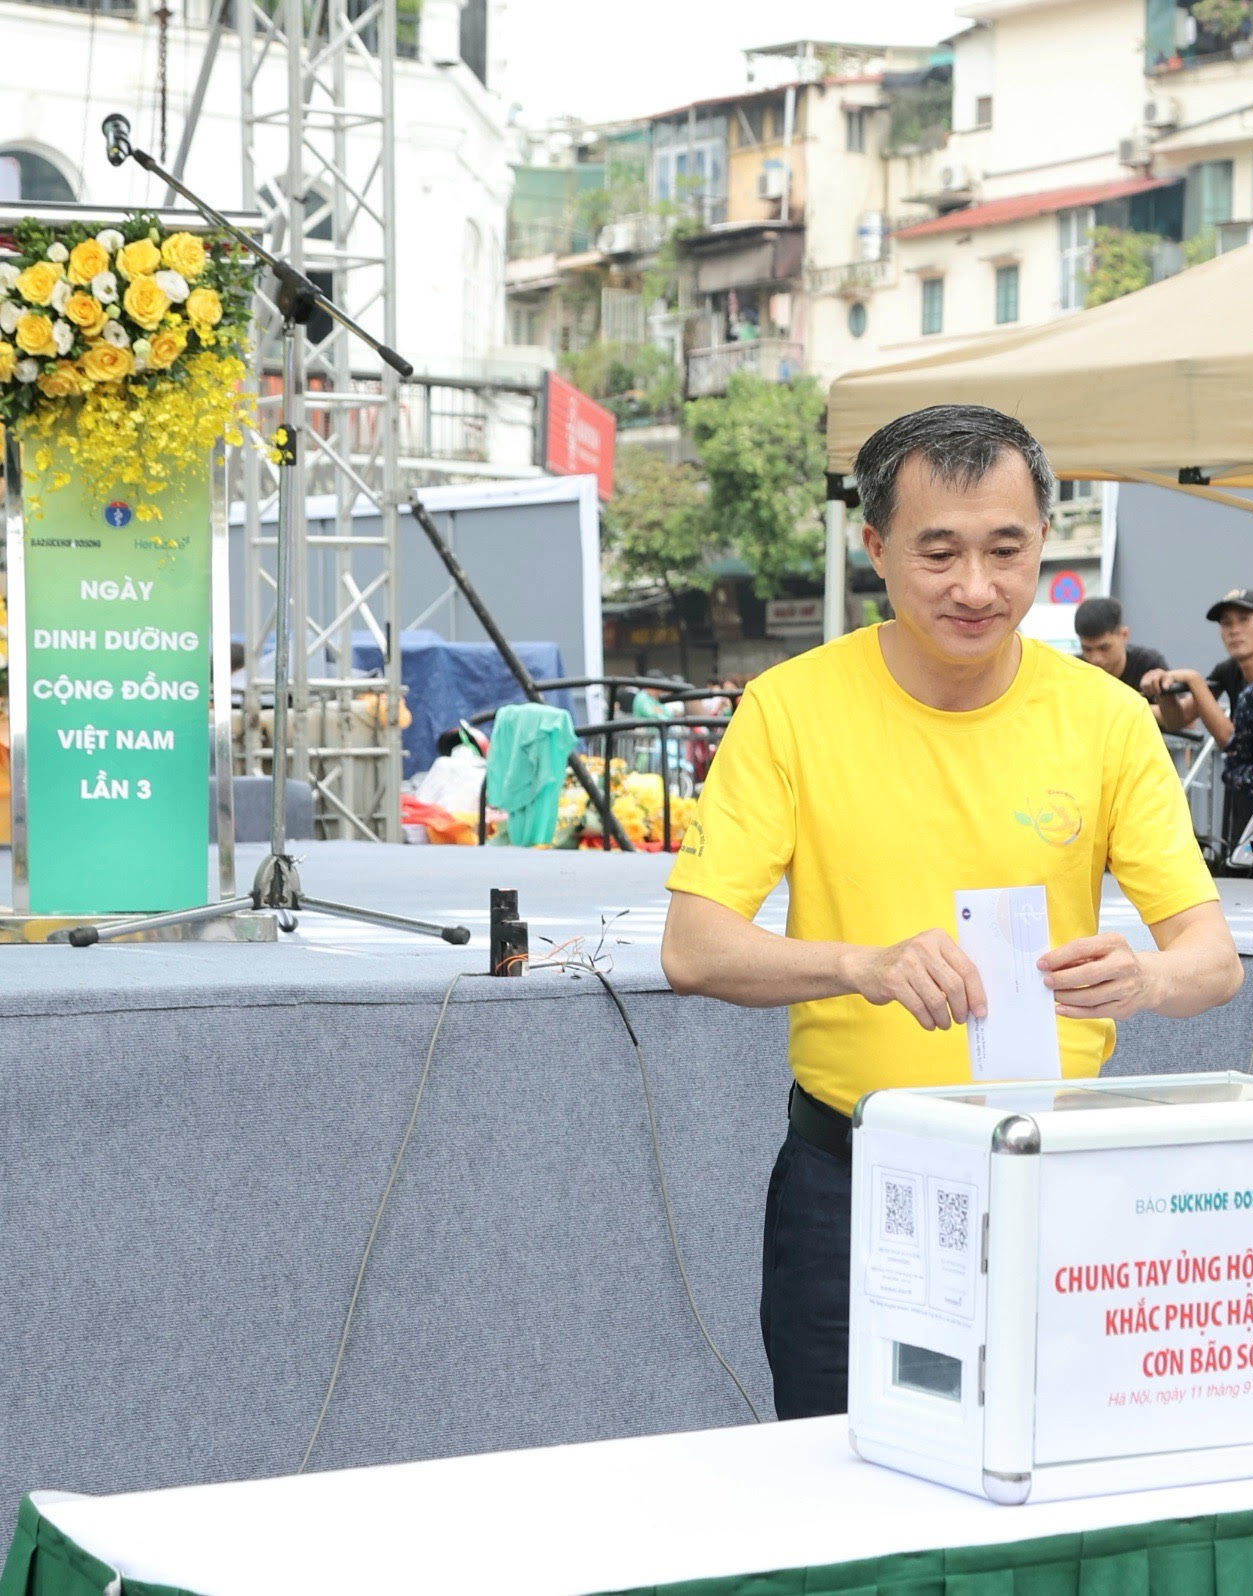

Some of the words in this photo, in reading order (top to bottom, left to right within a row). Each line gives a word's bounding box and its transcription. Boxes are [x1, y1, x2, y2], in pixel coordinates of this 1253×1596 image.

[80, 575, 154, 601] NGÀY
[33, 629, 97, 650] DINH
[104, 626, 199, 651] DƯỠNG
[32, 674, 114, 705] CỘNG
[121, 671, 200, 701] ĐỒNG
[57, 724, 110, 755] VIỆT
[116, 730, 175, 750] NAM
[80, 770, 129, 799] LẦN
[136, 779, 152, 800] 3
[1055, 1262, 1130, 1293] CHUNG
[1134, 1259, 1172, 1287] TAY
[1176, 1249, 1221, 1284] ỦNG
[1106, 1297, 1160, 1336] KHẮC
[1165, 1301, 1222, 1336] PHỤC
[1142, 1348, 1184, 1377] CƠN
[1190, 1340, 1232, 1374] BÃO
[1108, 1391, 1126, 1407] Hà
[1156, 1387, 1186, 1405] ngày
[1191, 1384, 1203, 1398] 11
[1207, 1382, 1240, 1398] tháng
[1243, 1380, 1252, 1393] 9
